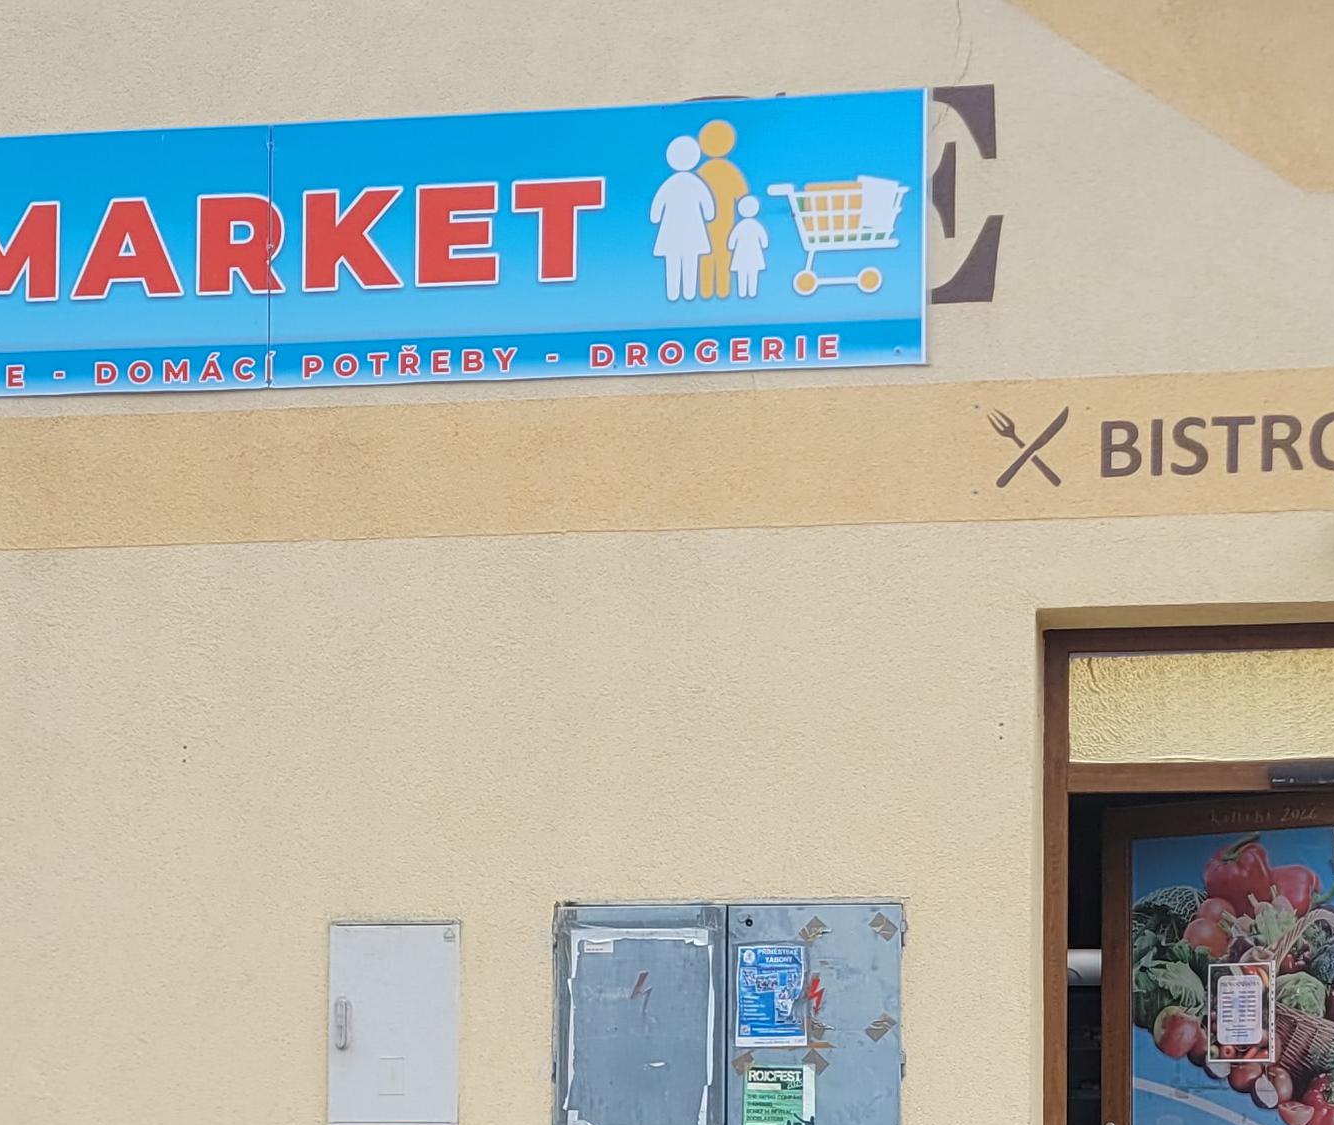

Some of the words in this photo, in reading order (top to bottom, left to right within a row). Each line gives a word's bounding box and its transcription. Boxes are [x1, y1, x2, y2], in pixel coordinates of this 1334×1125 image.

[94, 350, 276, 387] DOMÁCÍ
[302, 345, 518, 380] POTŘEBY
[590, 333, 841, 370] DROGERIE
